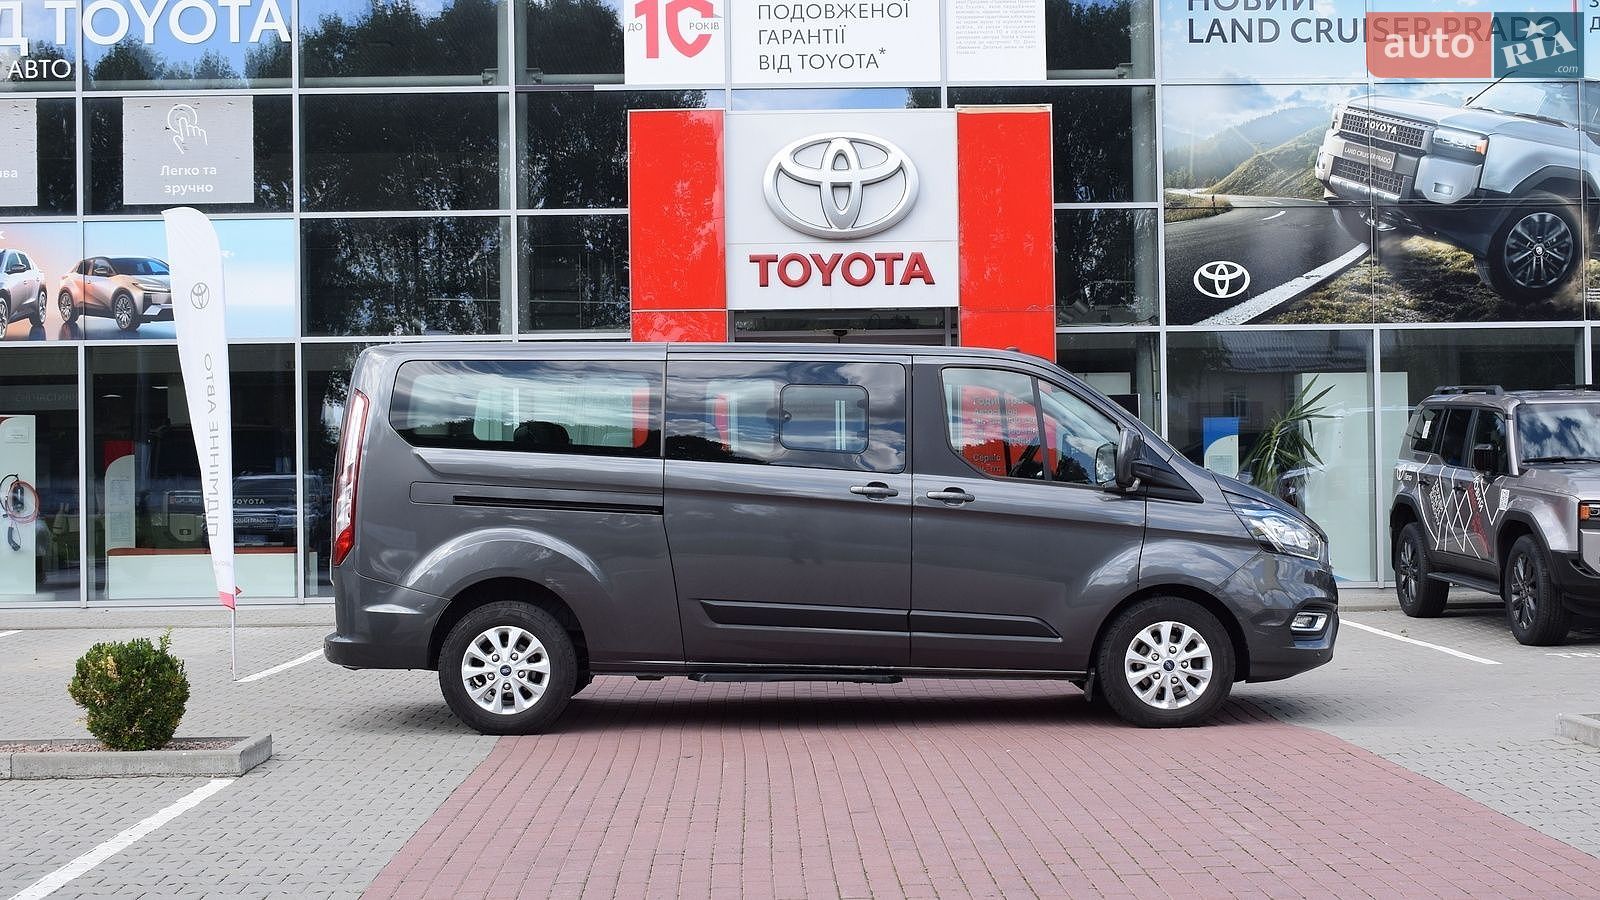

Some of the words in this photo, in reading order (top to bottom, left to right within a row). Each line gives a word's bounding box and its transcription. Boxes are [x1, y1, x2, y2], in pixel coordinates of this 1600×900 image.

[758, 0, 911, 23] ПОДОВЖЕНОЇ
[44, 0, 292, 46] TOYOTA
[627, 22, 643, 32] ДО
[689, 22, 720, 31] РОКІВ
[1187, 18, 1281, 44] LAND
[1290, 17, 1432, 44] CRUISER
[1443, 16, 1561, 43] PRADO
[758, 24, 847, 45] ГАРАНТІЇ
[7, 59, 72, 79] АВТО
[759, 54, 792, 73] ВІД
[1364, 120, 1397, 135] TOYOTA
[1344, 147, 1356, 155] LAND
[160, 165, 199, 177] Легко
[203, 166, 217, 176] та
[164, 183, 214, 197] зручно
[749, 251, 936, 288] TOYOTA
